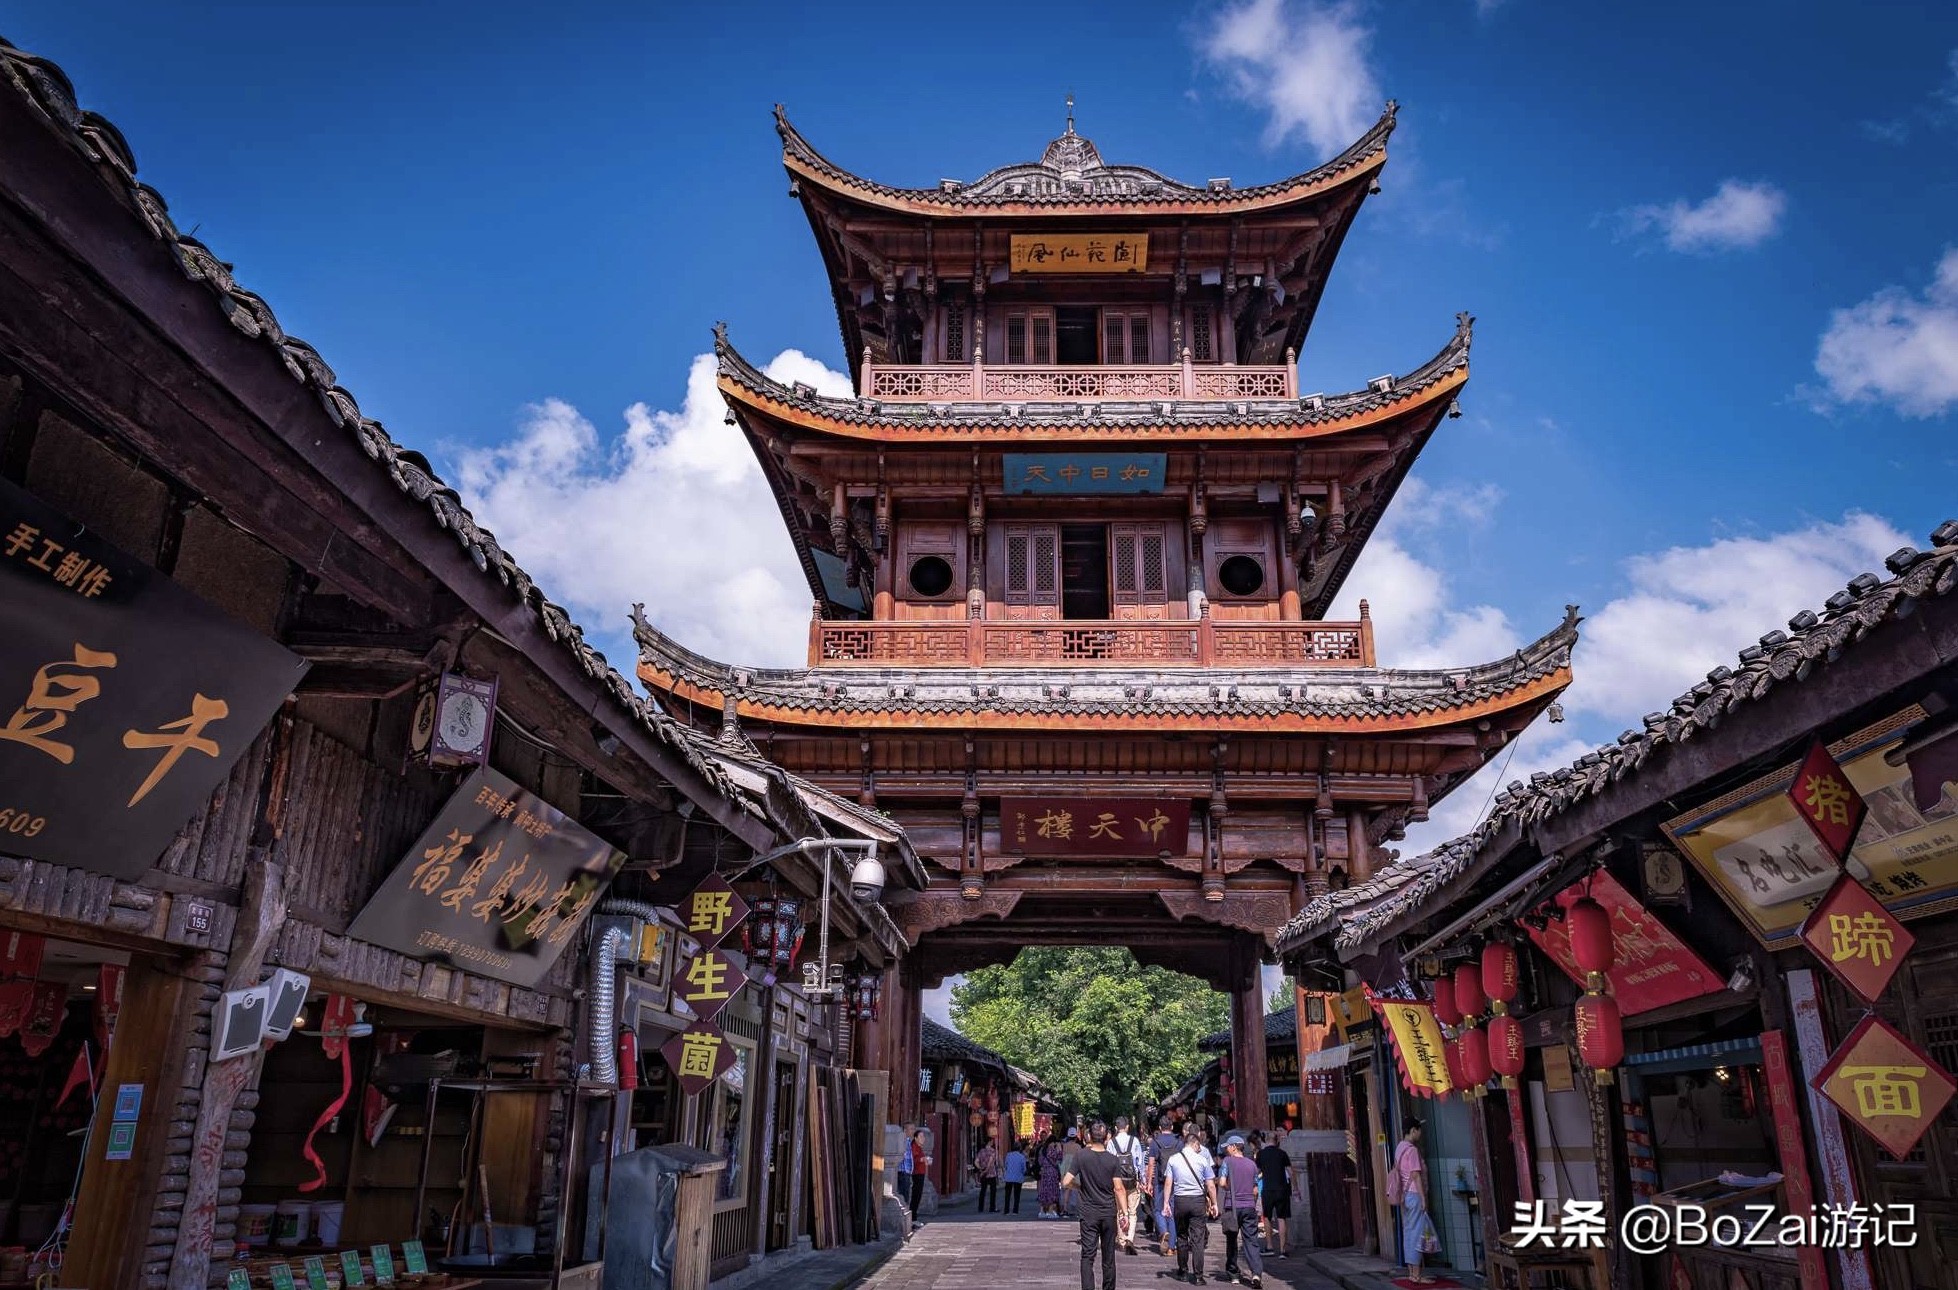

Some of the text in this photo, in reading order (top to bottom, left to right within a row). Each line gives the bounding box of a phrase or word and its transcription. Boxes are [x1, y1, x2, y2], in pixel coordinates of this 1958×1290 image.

[5, 522, 113, 598] 手工制作
[192, 916, 207, 929] 155
[678, 891, 733, 1079] 野生菌
